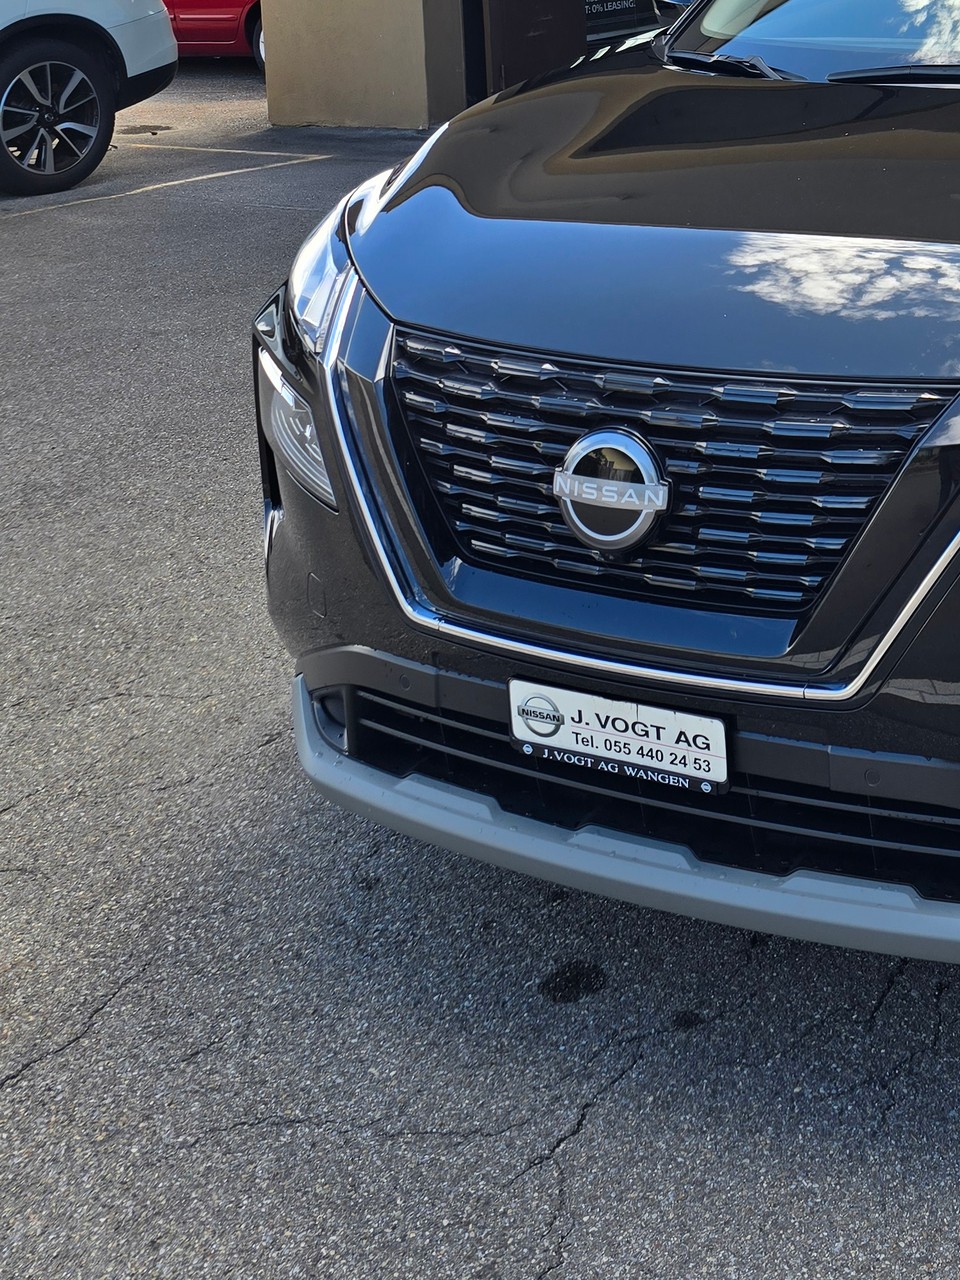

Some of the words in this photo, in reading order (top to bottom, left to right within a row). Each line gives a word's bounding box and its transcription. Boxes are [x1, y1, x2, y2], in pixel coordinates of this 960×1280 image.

[556, 476, 664, 506] NISSAN
[521, 708, 560, 722] NISSAN
[570, 710, 590, 726] J.
[595, 713, 666, 741] VOGT
[674, 730, 711, 751] AG
[571, 731, 599, 749] Tel.
[604, 738, 631, 755] 055
[636, 746, 664, 762] 440
[669, 752, 688, 768] 24
[693, 757, 711, 773] 53
[598, 761, 619, 773] AG
[624, 765, 690, 788] WANGEN
